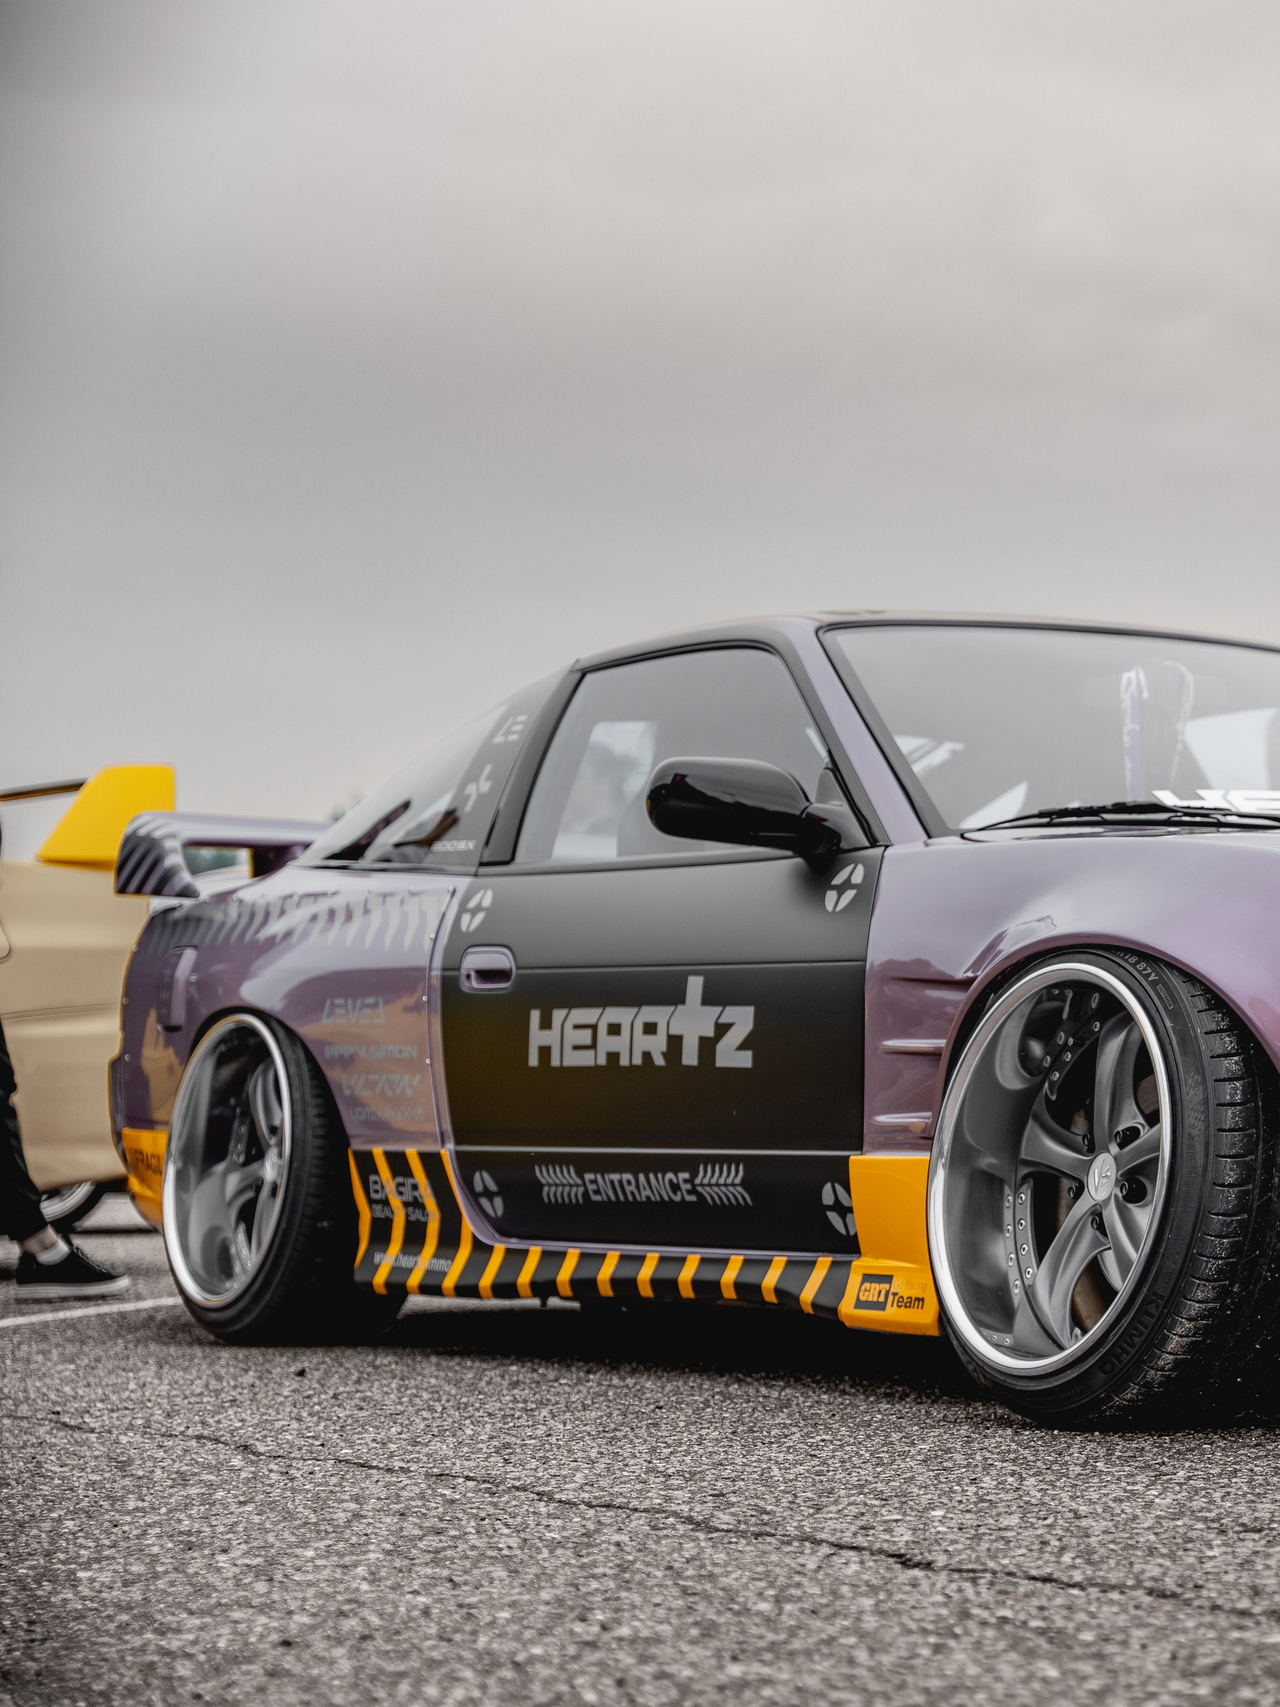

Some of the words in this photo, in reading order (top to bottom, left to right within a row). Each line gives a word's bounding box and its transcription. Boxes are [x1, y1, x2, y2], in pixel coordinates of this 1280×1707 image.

[528, 975, 755, 1068] HEARTZ
[368, 1173, 439, 1206] BAGIRA
[583, 1171, 698, 1203] ENTRANCE
[890, 1291, 926, 1311] Team
[1100, 1291, 1166, 1376] KUMHO
